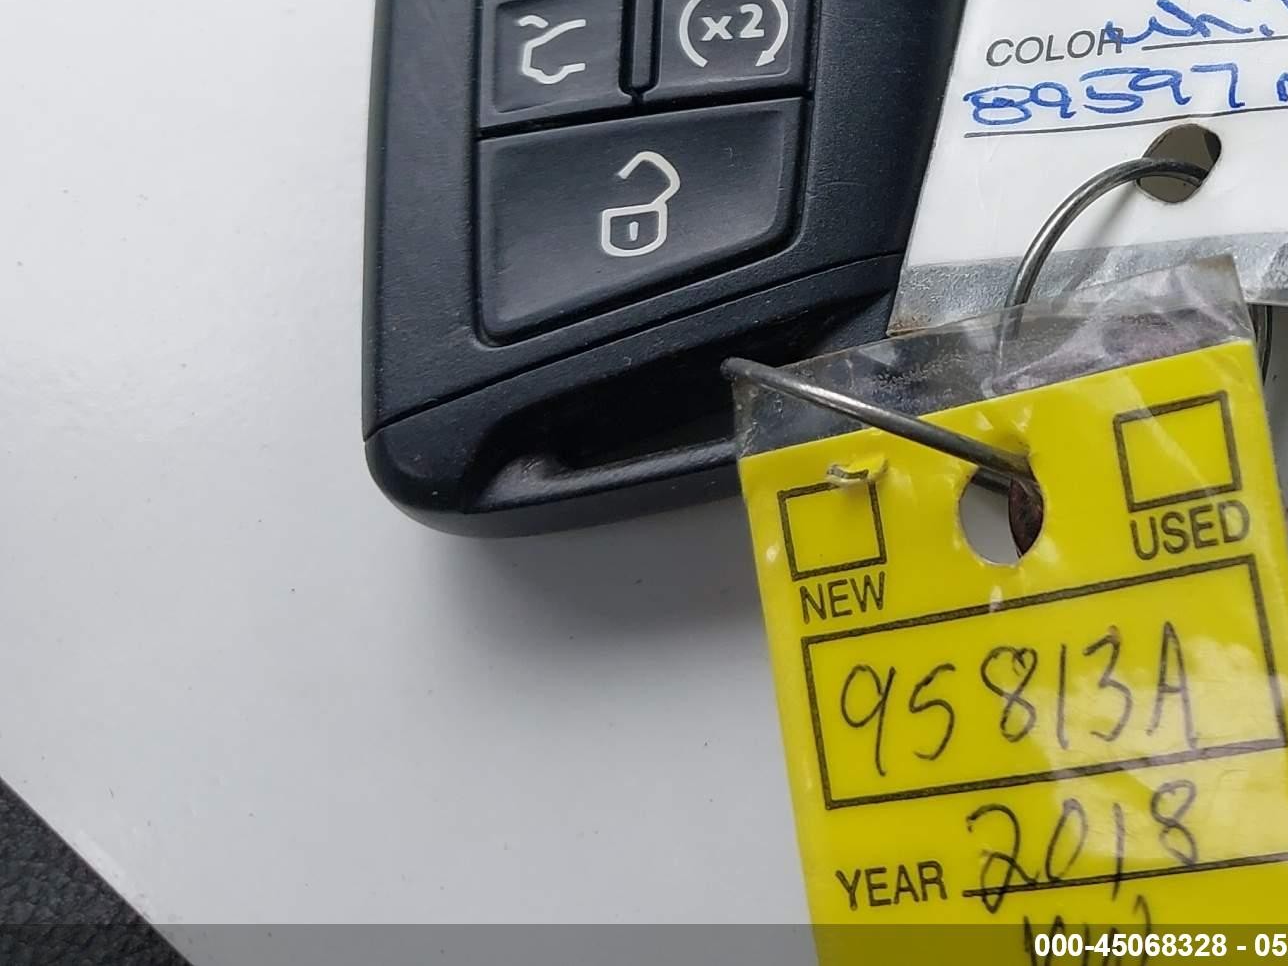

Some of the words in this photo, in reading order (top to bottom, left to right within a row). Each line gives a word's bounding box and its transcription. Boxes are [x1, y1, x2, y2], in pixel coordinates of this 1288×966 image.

[701, 4, 765, 42] x2
[985, 27, 1125, 67] COLOR
[1130, 499, 1252, 561] USED
[800, 571, 888, 624] NEW
[839, 620, 1197, 778] 95813A
[965, 777, 1201, 914] 2018
[835, 859, 949, 911] YEAR
